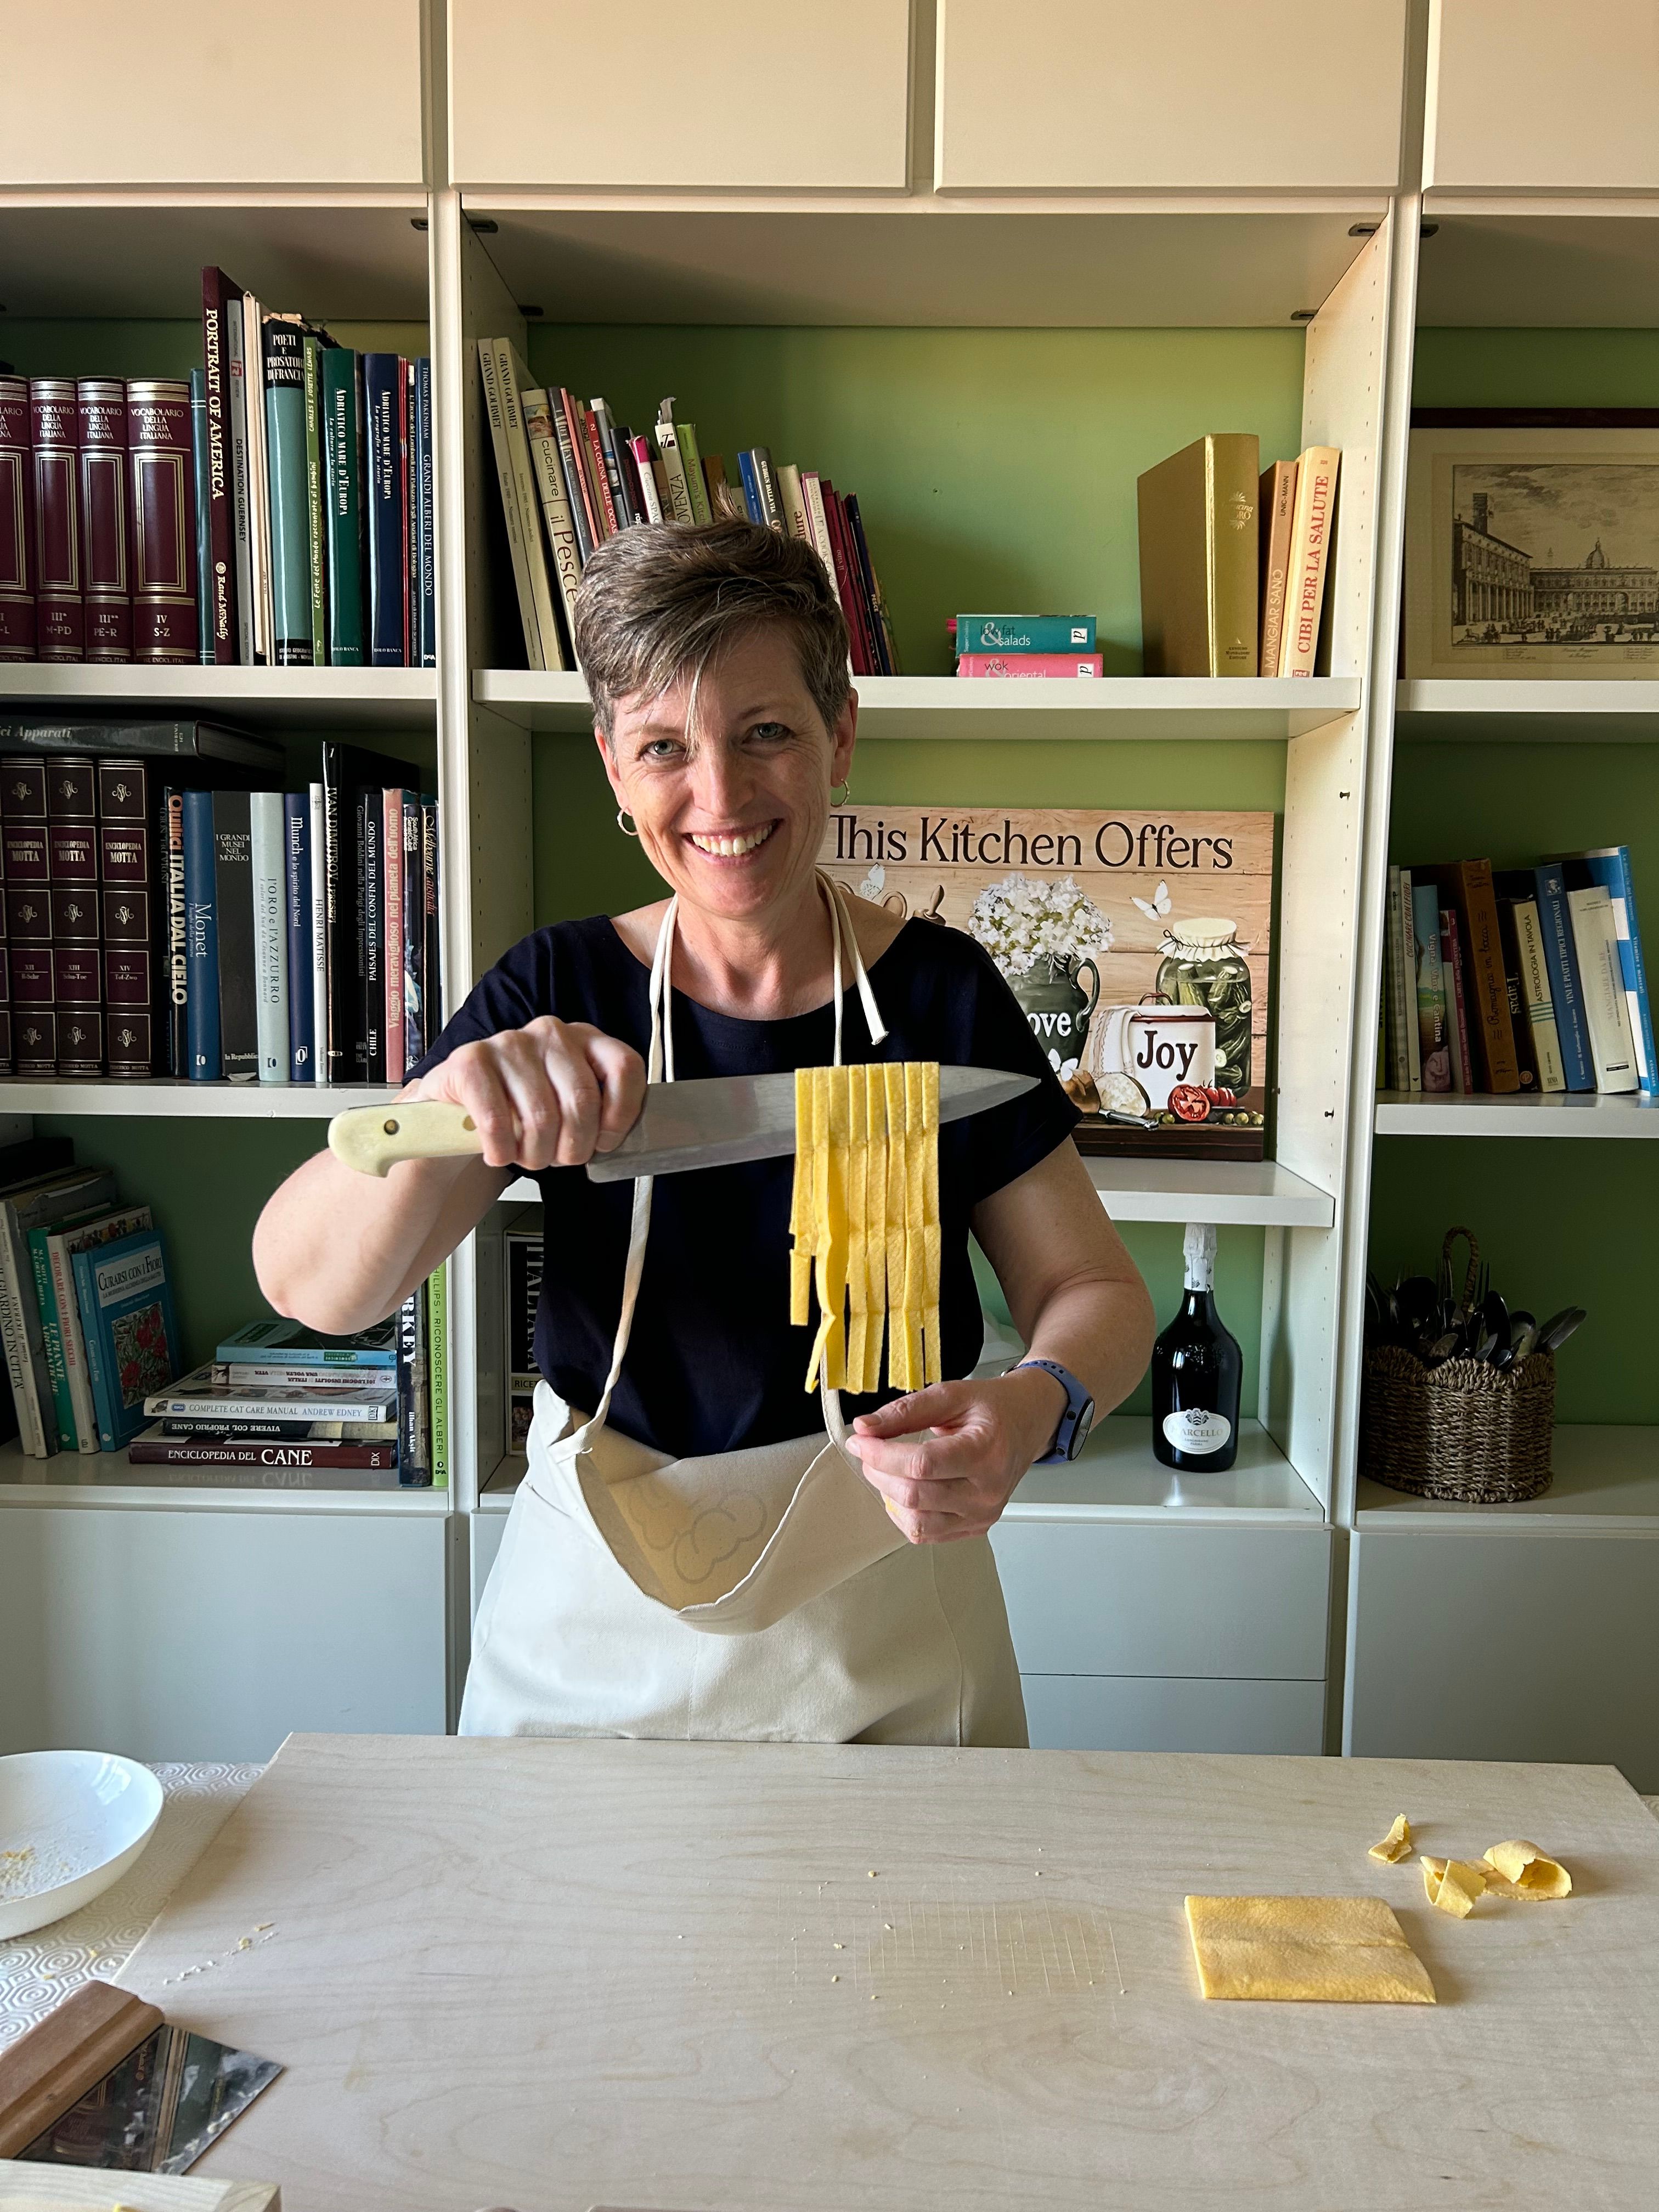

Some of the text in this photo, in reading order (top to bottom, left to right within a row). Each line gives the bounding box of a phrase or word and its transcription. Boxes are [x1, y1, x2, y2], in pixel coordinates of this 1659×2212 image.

[273, 334, 296, 346] POETI
[33, 405, 75, 415] VOCABOLARIO
[206, 308, 224, 500] PORTRAIT OF AMERICA
[482, 353, 501, 429] GRAND GOURMET
[499, 353, 518, 430] GRAND GOURMET
[42, 422, 63, 430] LINGUA
[80, 407, 122, 416] VOCABOLARIO
[131, 408, 184, 417] VOCABOLARIO
[144, 416, 167, 424] DELLA
[336, 388, 347, 438] ADRIATICO
[382, 390, 391, 433] ADRIATICO
[40, 430, 66, 438] ITALIANA
[87, 431, 114, 439] ITALIANA
[140, 432, 173, 440] ITALIANA
[338, 442, 347, 466] MARE
[592, 440, 612, 506] LA CUCINA DELLE
[760, 460, 770, 483] GUDRUN
[235, 439, 247, 542] DESTINATION GUERNSEY
[644, 472, 655, 496] Cucina
[688, 459, 701, 500] Mayumi's
[423, 455, 432, 596] GRANDI ALBERI DEL MONDO
[541, 440, 578, 603] cucinare il Pesce
[1297, 476, 1329, 653] CIBI PER LA SALUTE
[217, 576, 226, 602] Rand
[314, 600, 321, 608] Le
[154, 628, 171, 636] S-Z
[157, 615, 167, 623] IV
[980, 625, 1015, 636] low fat
[1265, 568, 1284, 667] MANGIAR SANO
[1000, 635, 1031, 646] salads
[985, 661, 1008, 670] wok
[17, 726, 72, 741] Apparati
[328, 787, 337, 816] IVAN
[12, 851, 40, 862] MOTTA
[59, 851, 86, 862] MOTTA
[110, 852, 138, 864] MOTTA
[830, 815, 1234, 870] This Kitchen Offers
[291, 816, 303, 927] Munch spirito del Nord
[425, 815, 437, 916] Melbourne australia
[356, 886, 365, 907] Parigi
[367, 821, 377, 981] PAISAJES DEL CONFIN DEL MUNDO
[170, 855, 188, 1005] ITALIA DAL CIELO
[195, 902, 212, 958] Monet
[315, 899, 325, 972] HENRI MATISSE
[387, 808, 401, 1029] Viaggio meraviglioso nel pianeta dell'uomo
[1552, 900, 1564, 938] REGIONALI
[267, 878, 280, 1003] l'ORO l'AZZURRO
[358, 928, 366, 977] Impressionisti
[1524, 915, 1544, 1002] ASTROLOGIA IN TAVOLA
[1426, 934, 1442, 1042] Vigna, Vino Cantina
[1477, 925, 1502, 1026] Romagna bocca
[1506, 972, 1522, 1014] Tapas
[369, 1029, 377, 1056] CHILE
[1027, 1011, 1072, 1038] ove
[1136, 1030, 1199, 1081] Joy
[52, 1252, 64, 1291] DECORARE
[99, 1270, 128, 1291] CURARSI
[128, 1265, 142, 1280] CON
[145, 1255, 163, 1273] FIORI
[400, 1296, 416, 1367] RKEY
[51, 1339, 66, 1382] PIANTE
[433, 1318, 443, 1395] RICONOSCERE
[189, 1404, 228, 1414] COMPLETE
[229, 1405, 245, 1414] CAT
[246, 1406, 266, 1414] CARE
[267, 1406, 298, 1415] MANUAL
[302, 1407, 335, 1416] ANDREW
[336, 1407, 362, 1417] EDNEY
[168, 1449, 313, 1466] ENCICLOPEDIA DEL CANE
